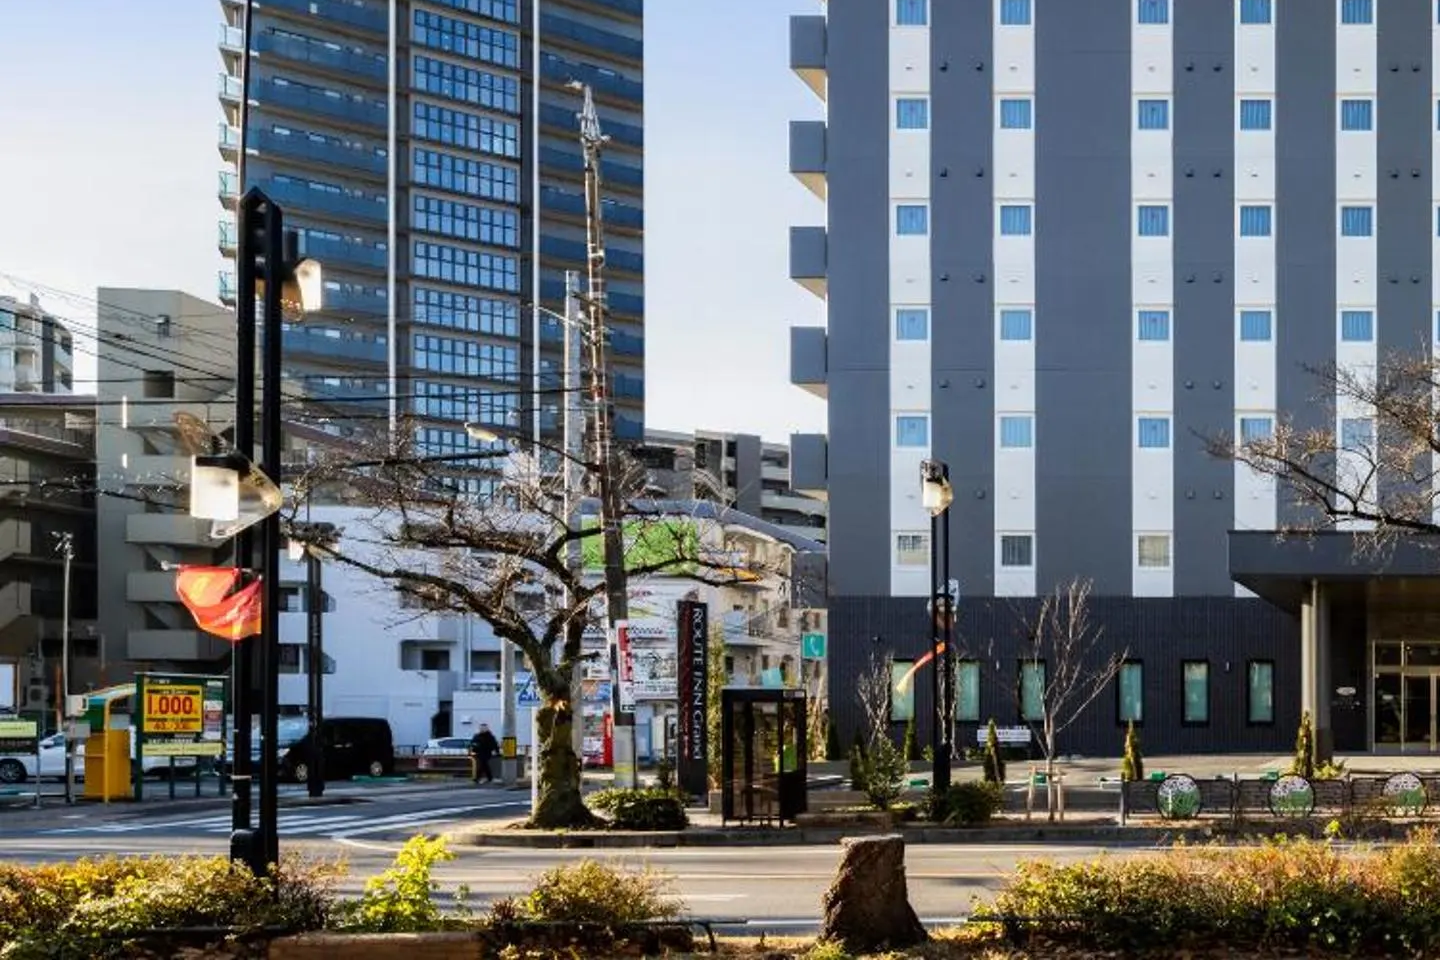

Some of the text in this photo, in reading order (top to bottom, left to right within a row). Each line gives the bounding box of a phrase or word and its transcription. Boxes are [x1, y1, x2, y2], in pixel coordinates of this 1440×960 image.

[693, 608, 704, 760] ROUTE INN Grand
